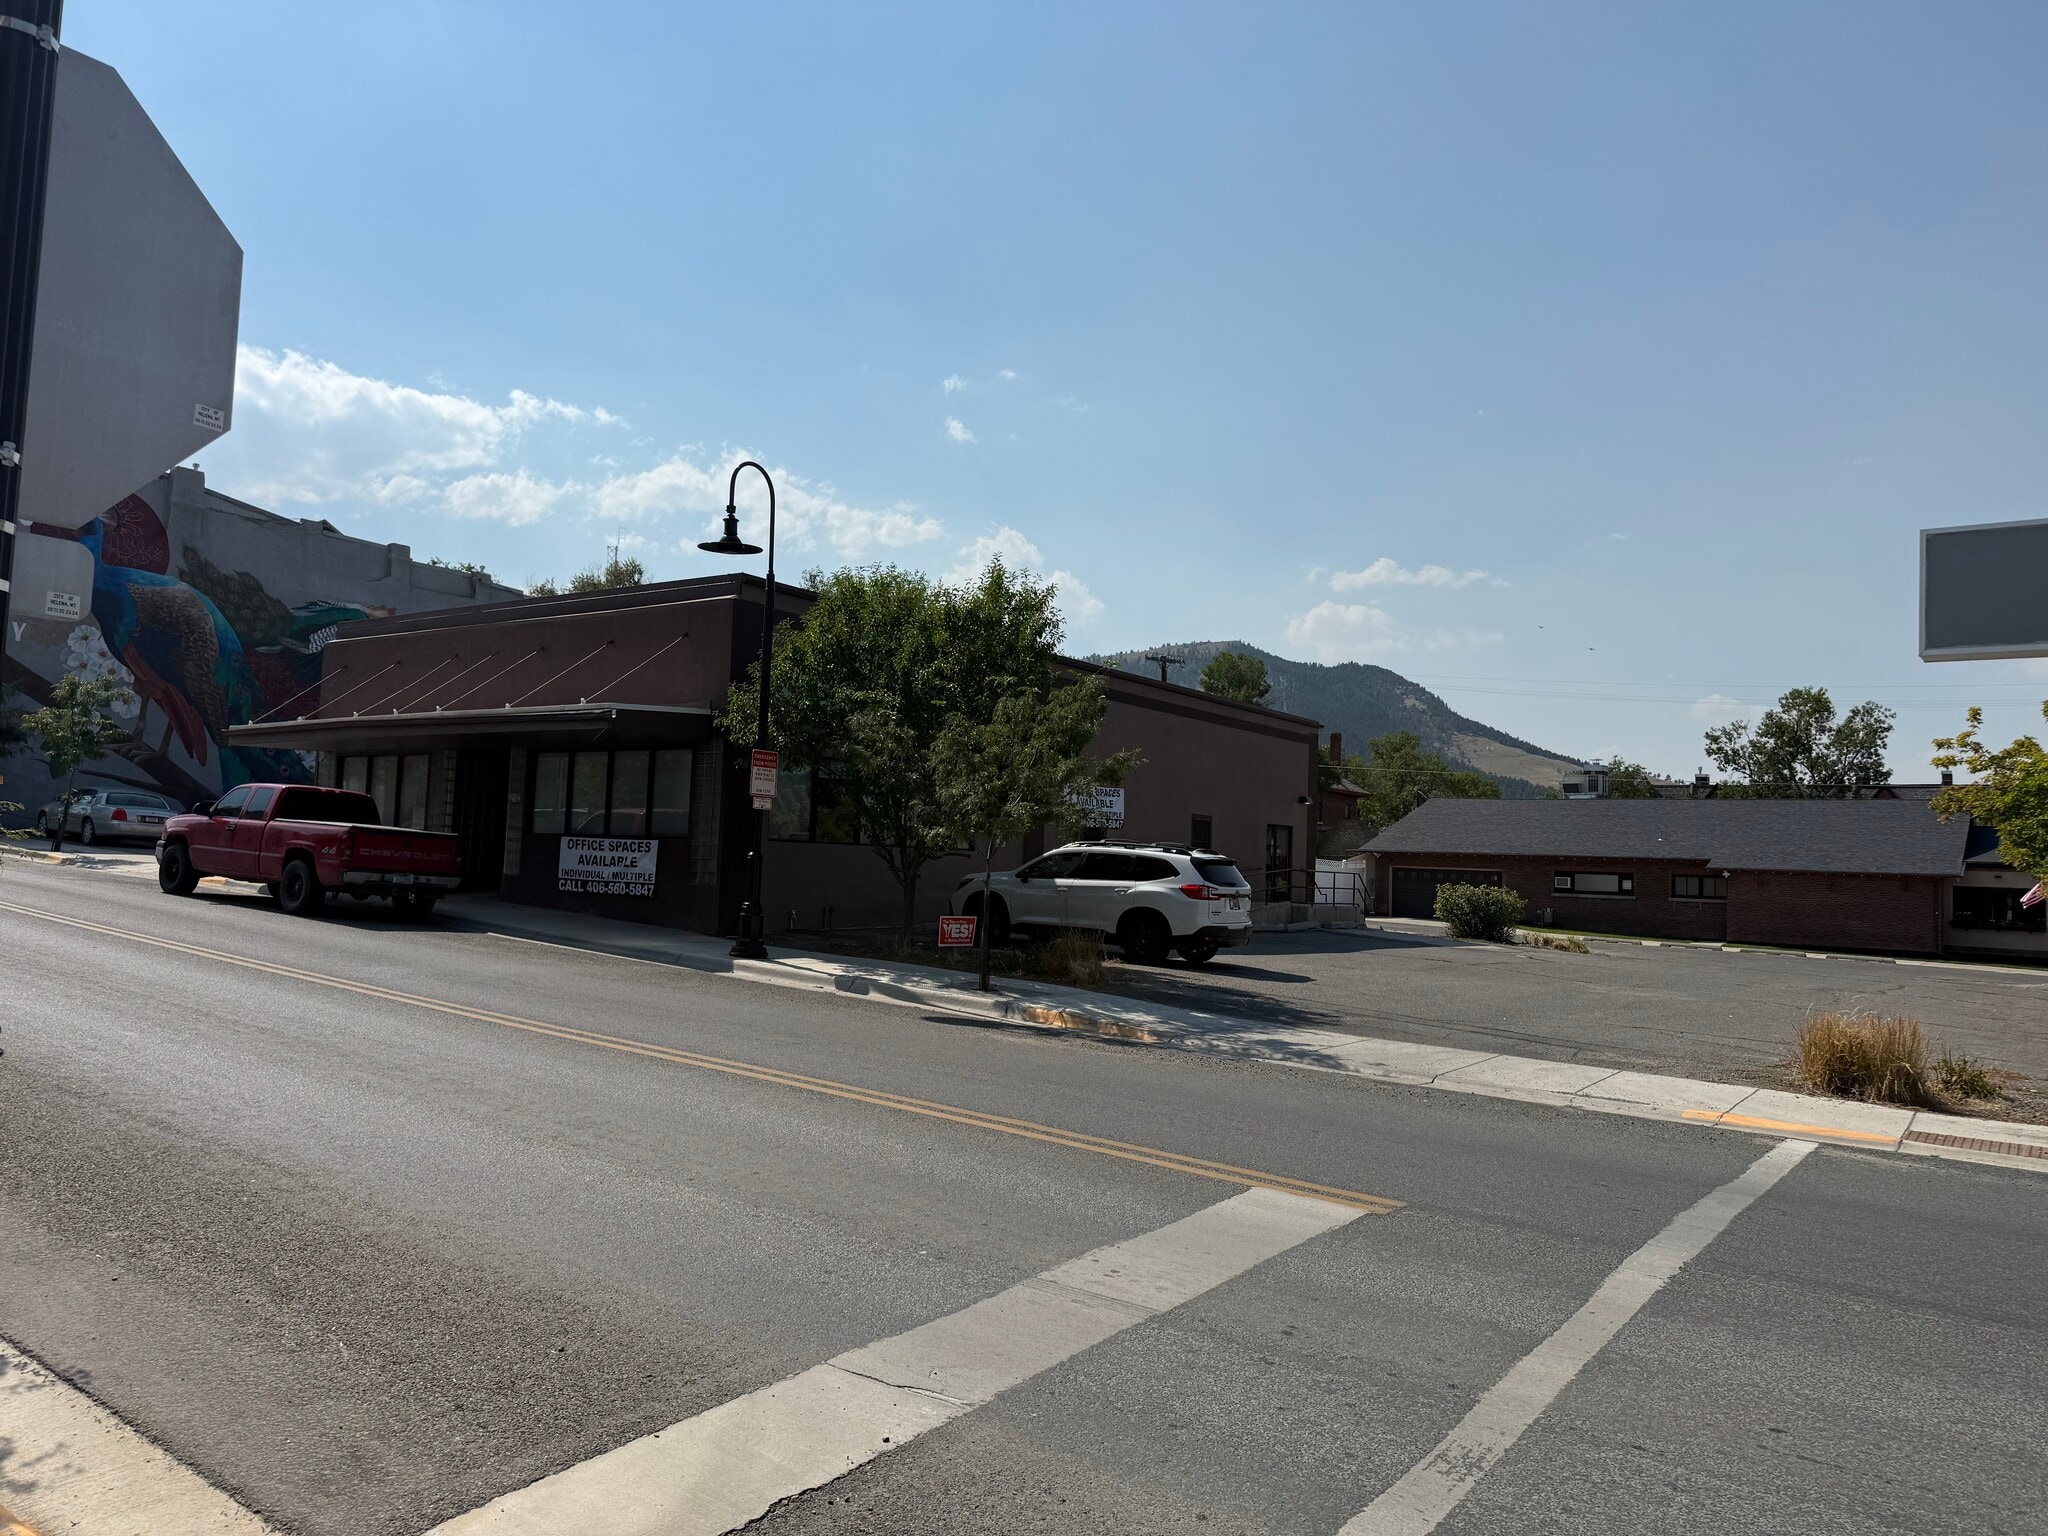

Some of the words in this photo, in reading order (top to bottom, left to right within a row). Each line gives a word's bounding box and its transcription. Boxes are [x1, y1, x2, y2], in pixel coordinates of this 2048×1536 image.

[1095, 788, 1121, 798] SPACES
[1077, 796, 1114, 809] AVAILABLE
[567, 838, 605, 851] OFFICE
[608, 840, 652, 853] SPACES
[359, 847, 451, 861] CHEVROLET
[577, 854, 638, 868] AVAILABLE
[561, 868, 605, 880] INDIVIDUAL
[612, 871, 654, 882] MULTIPLE
[558, 879, 584, 892] CALL
[586, 881, 655, 896] 406-560-5847
[942, 923, 974, 938] YES!
